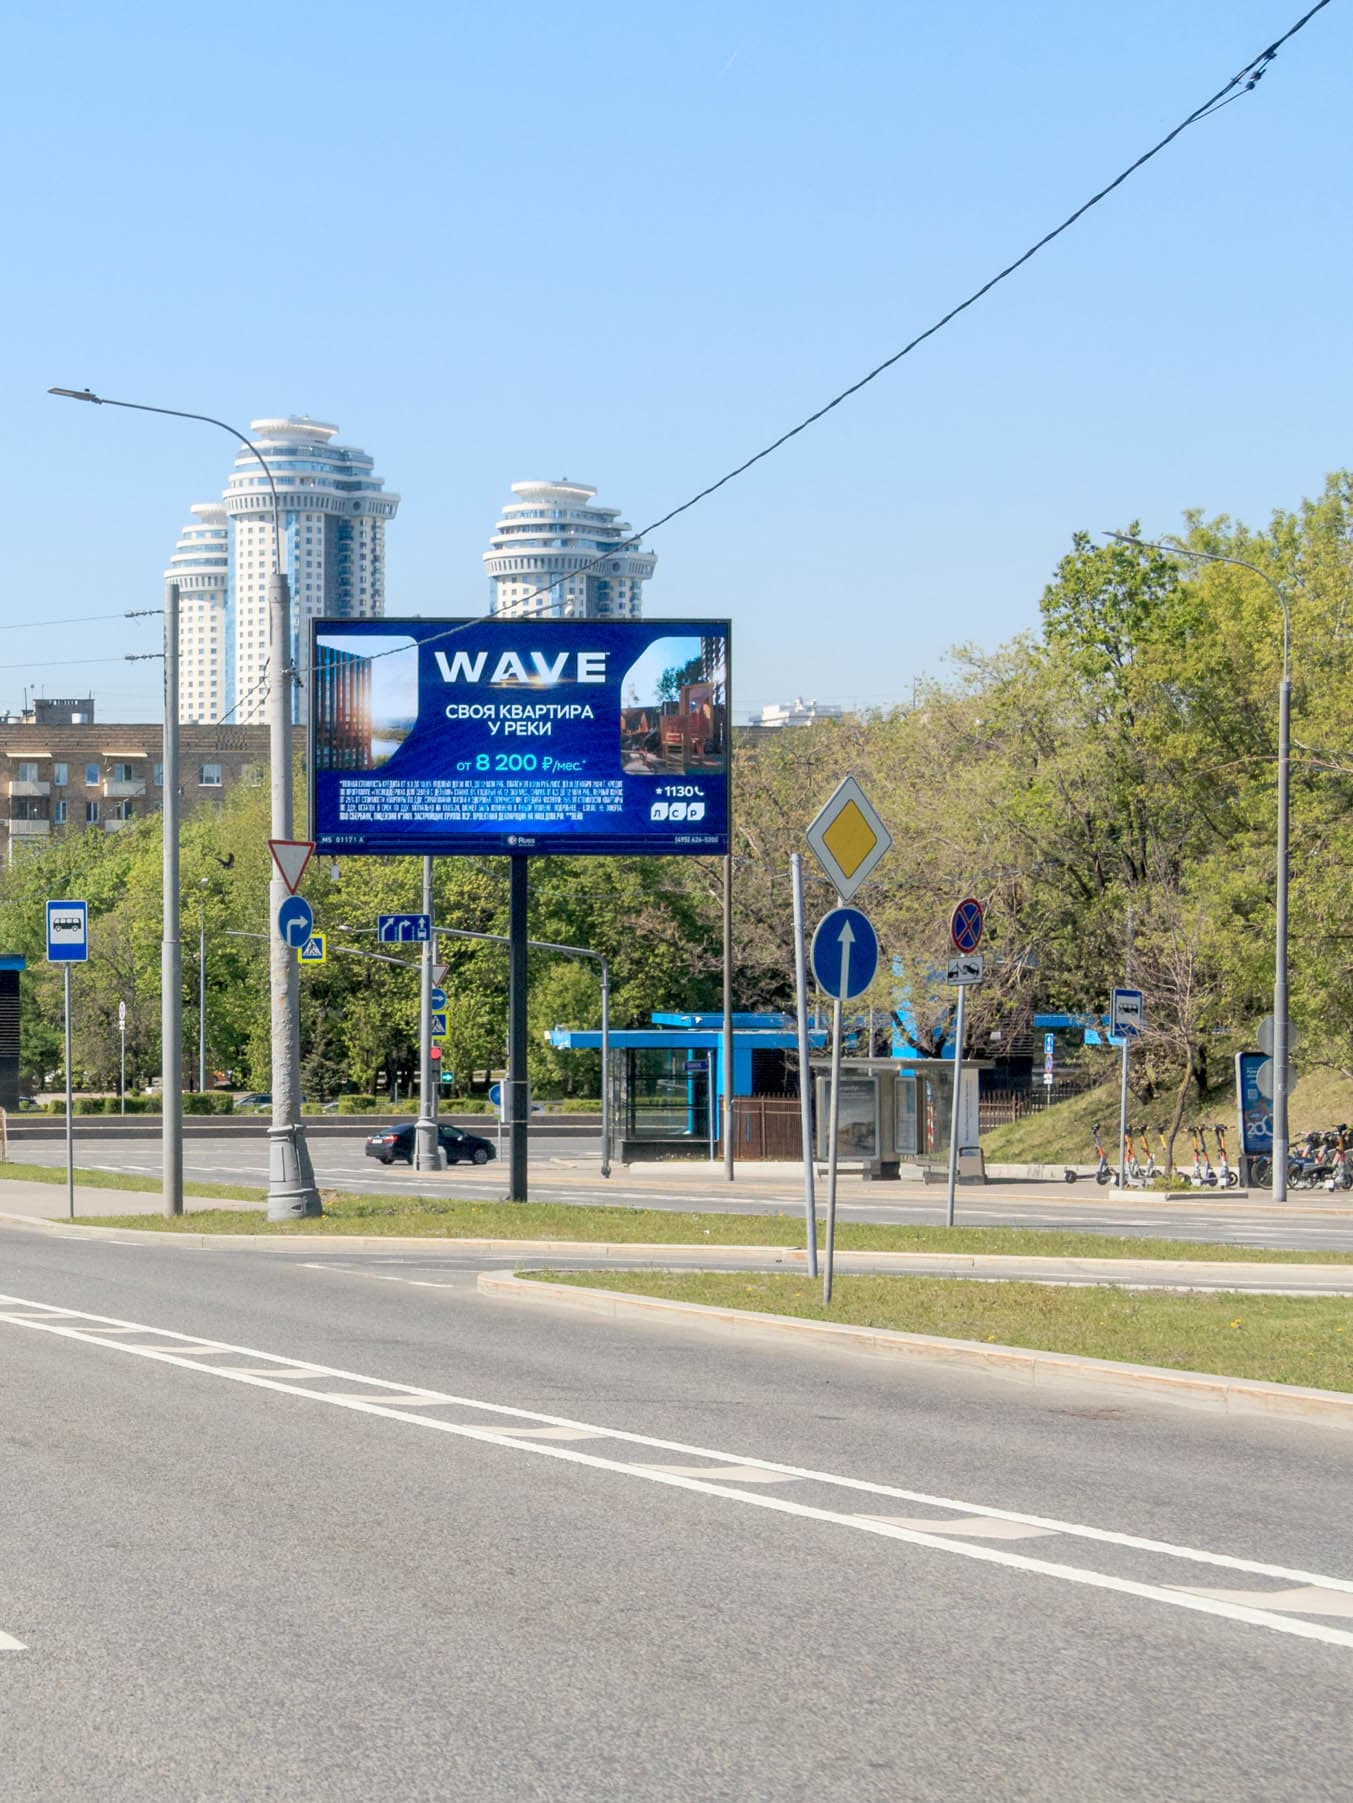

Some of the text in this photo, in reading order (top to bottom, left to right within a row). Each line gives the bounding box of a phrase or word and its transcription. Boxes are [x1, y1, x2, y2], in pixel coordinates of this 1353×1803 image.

[434, 651, 606, 683] WAVE
[445, 704, 594, 719] СВОЯ КВАРТИРА
[487, 721, 552, 736] У РЕКИ
[456, 761, 472, 771] от
[475, 753, 490, 771] 8
[495, 753, 537, 771] 200
[652, 808, 699, 819] ЛСР
